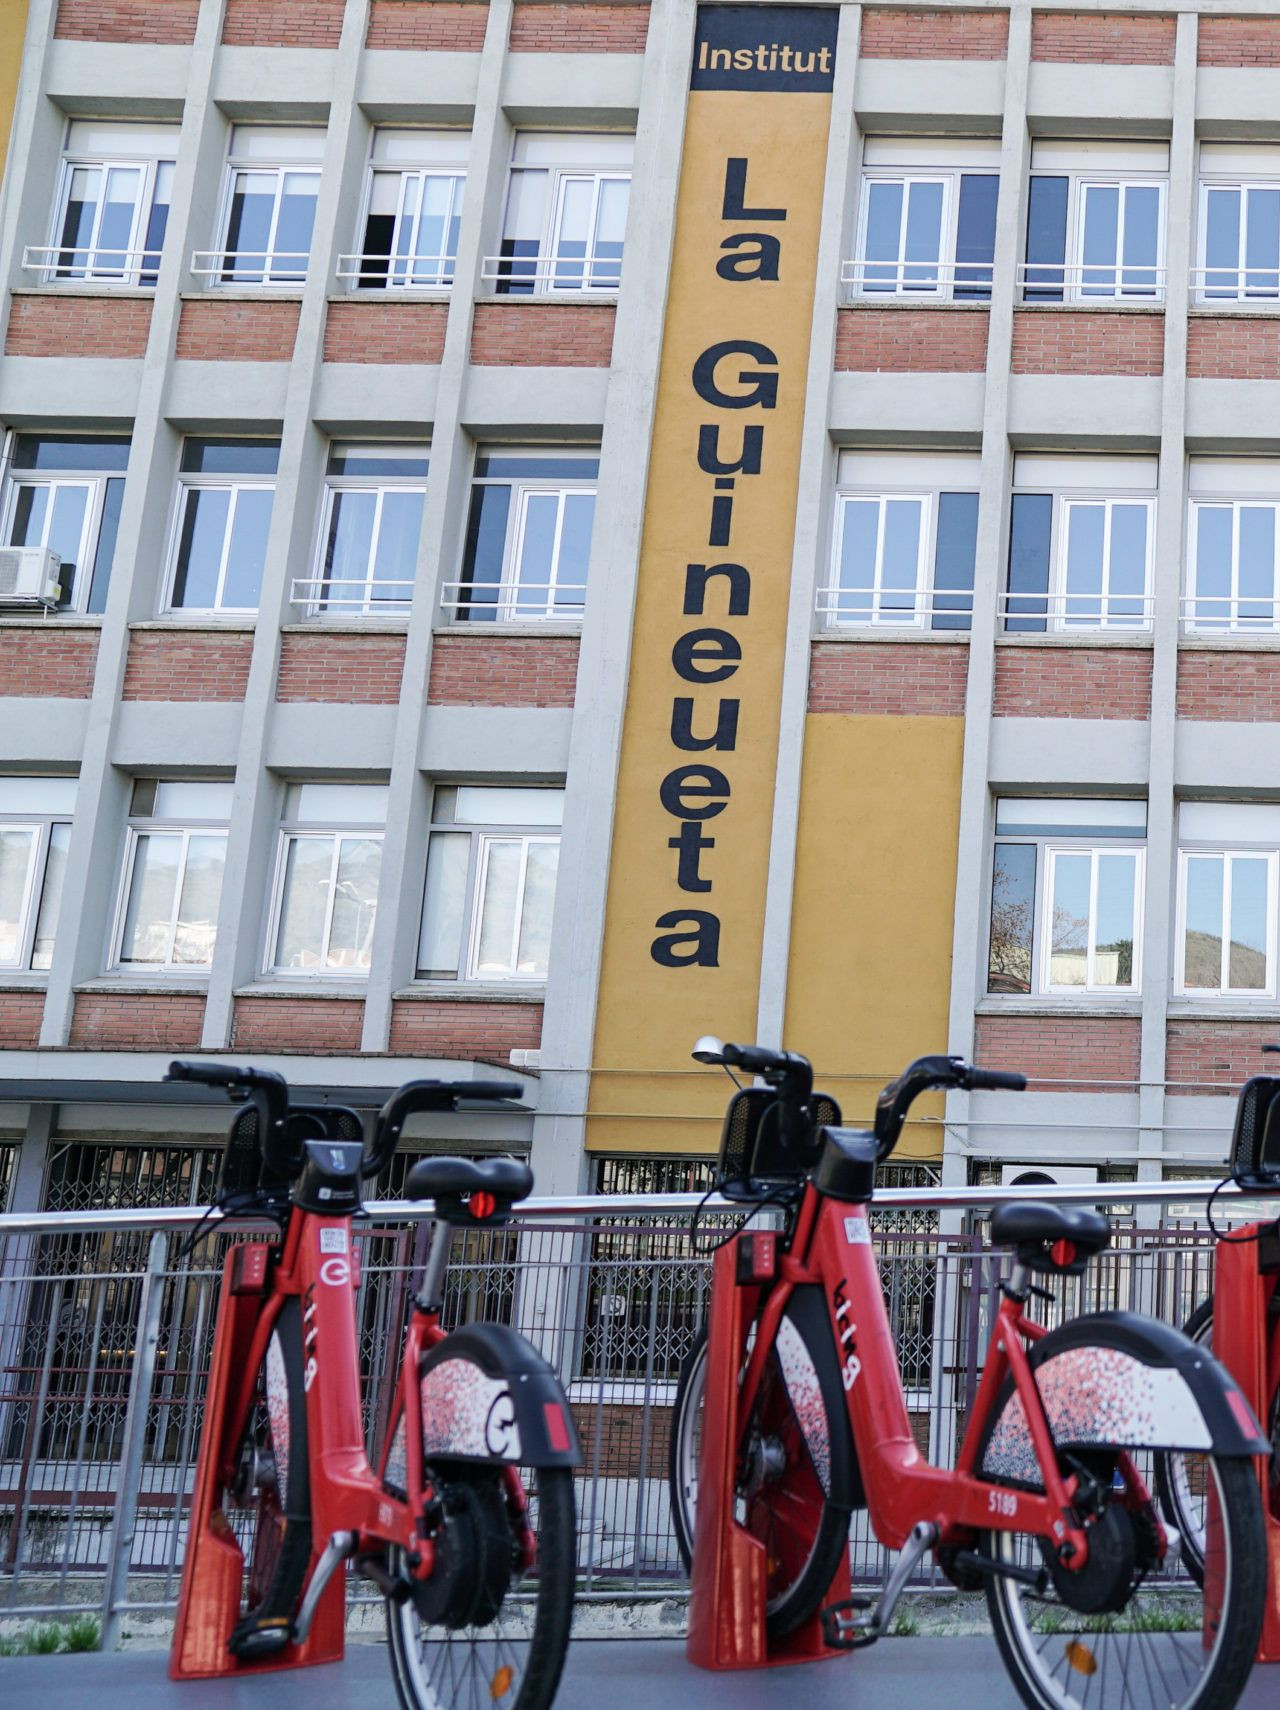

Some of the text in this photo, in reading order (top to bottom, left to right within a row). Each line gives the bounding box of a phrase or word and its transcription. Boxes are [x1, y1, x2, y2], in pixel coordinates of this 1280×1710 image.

[698, 41, 832, 74] Institut
[650, 157, 787, 968] La Guineueta
